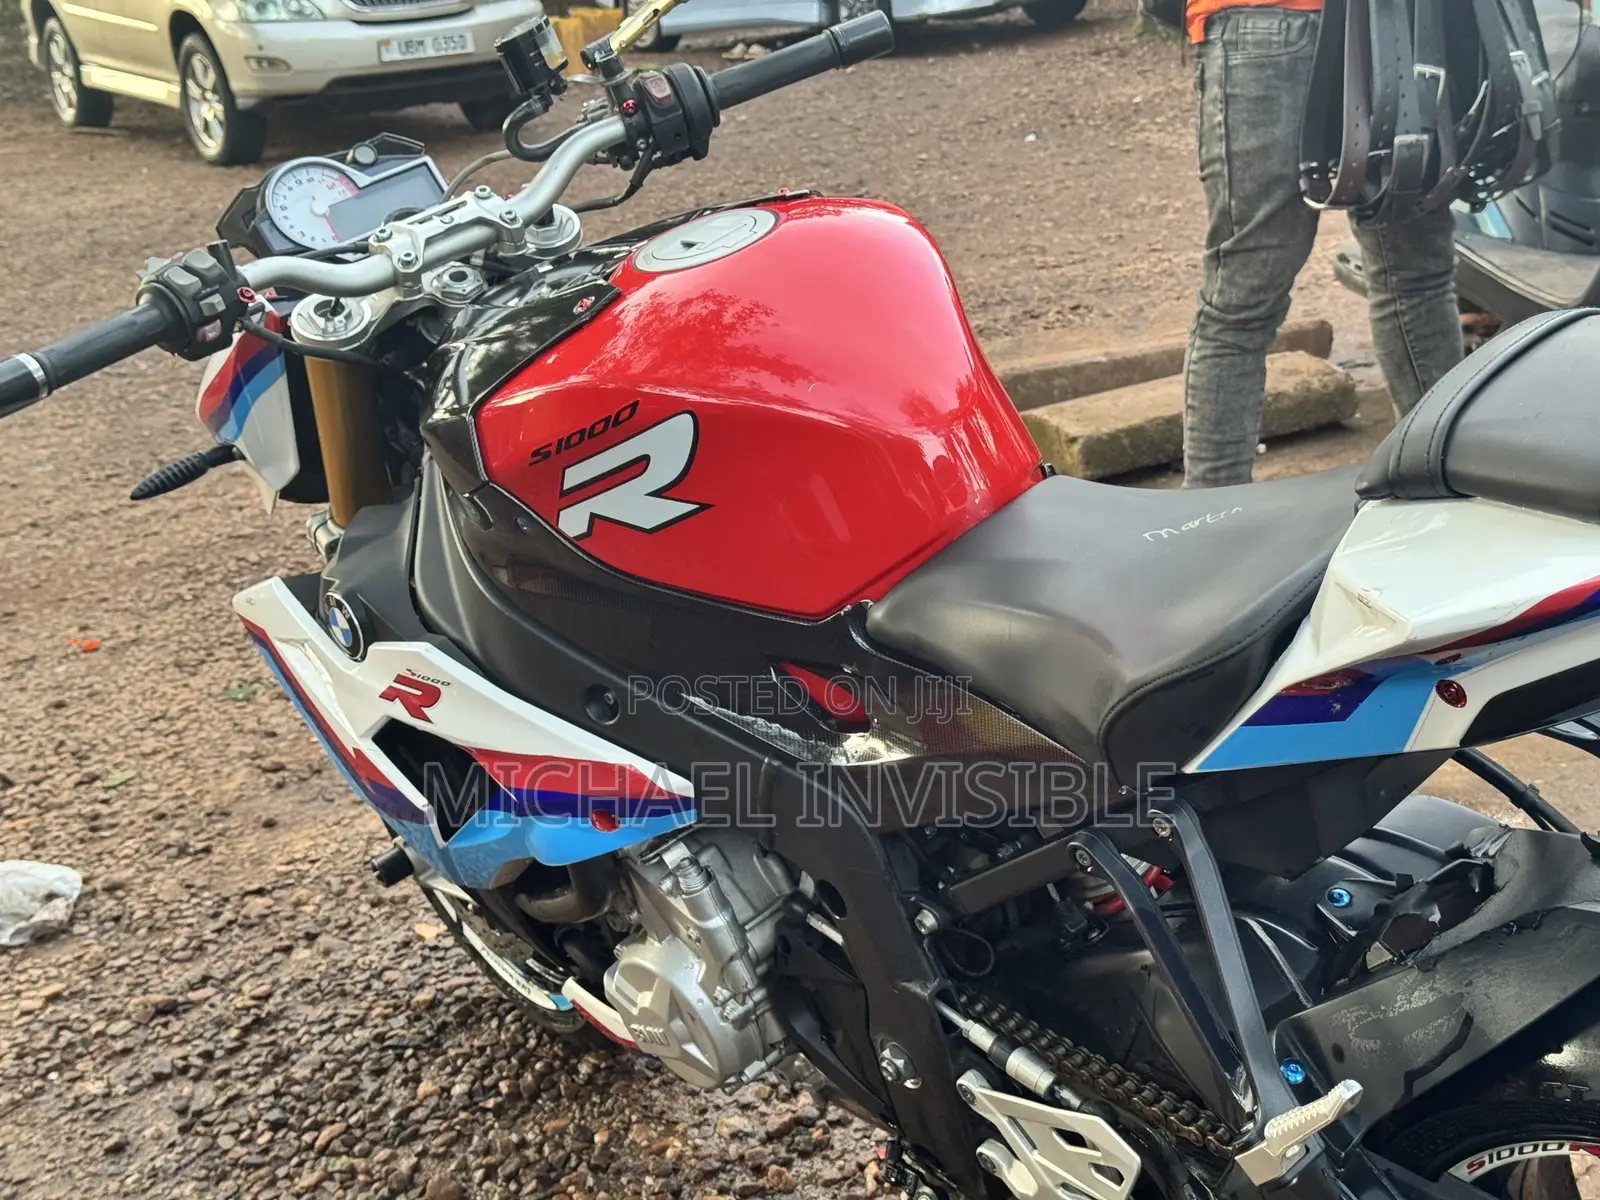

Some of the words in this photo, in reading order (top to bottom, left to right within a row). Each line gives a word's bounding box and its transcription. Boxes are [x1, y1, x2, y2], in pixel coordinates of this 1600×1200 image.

[528, 399, 641, 467] S1000
[556, 408, 716, 542] R
[378, 673, 442, 725] R
[404, 667, 452, 687] S1000
[1465, 1142, 1566, 1176] S1000
